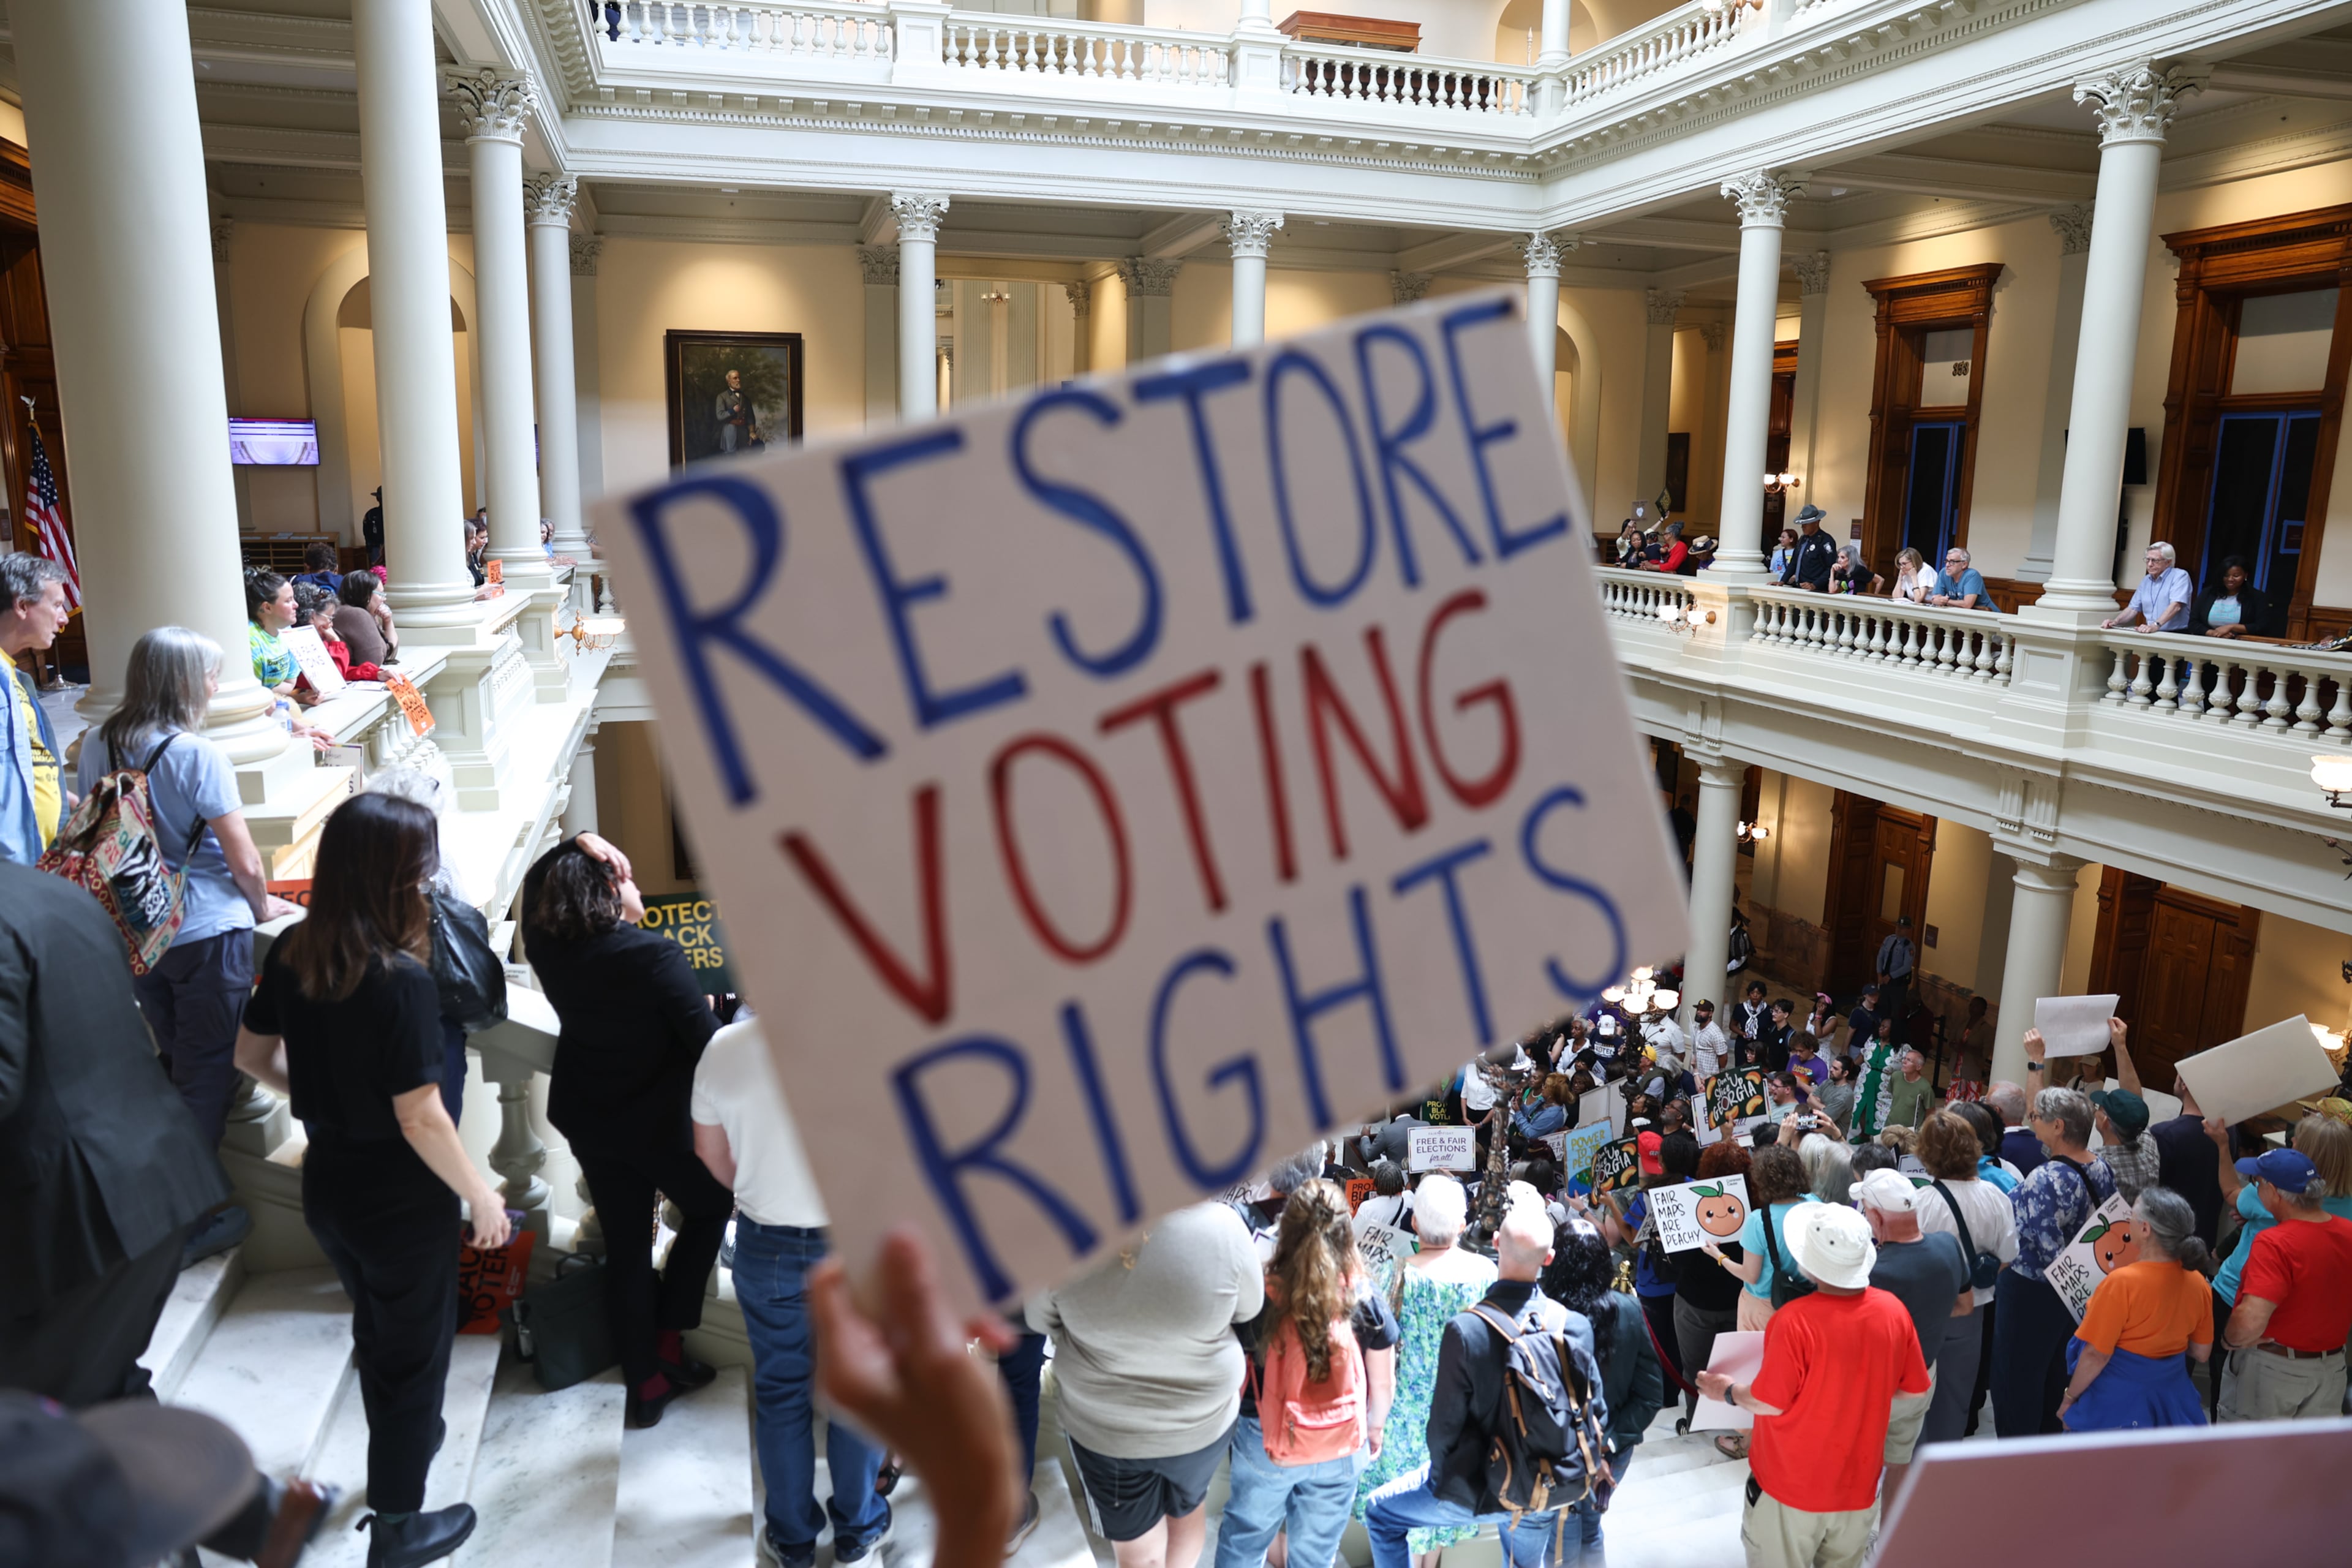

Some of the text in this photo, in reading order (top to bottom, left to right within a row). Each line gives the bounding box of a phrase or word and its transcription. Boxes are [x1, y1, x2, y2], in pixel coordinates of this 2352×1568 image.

[627, 298, 1571, 808] RESTORE
[777, 589, 1523, 1027] VOTING
[637, 899, 723, 929] OTECT
[663, 924, 715, 948] ACK
[891, 786, 1630, 1303] RIGHTS
[1713, 1080, 1757, 1121] GEORGIA
[1714, 1084, 1731, 1101] Slice
[1416, 1145, 1467, 1154] ELECTIONS
[1571, 1129, 1605, 1151] POWER
[1429, 1153, 1439, 1164] for
[1577, 1147, 1588, 1159] TO
[1654, 1190, 1678, 1206] FAIR
[1657, 1203, 1685, 1219] MAPS
[1363, 1226, 1394, 1246] FAIR
[1662, 1219, 1681, 1234] ARE
[1665, 1229, 1701, 1247] PEACHY
[2051, 1255, 2076, 1283] FAIR
[2060, 1264, 2089, 1296] MAPS
[2070, 1283, 2091, 1309] ARE
